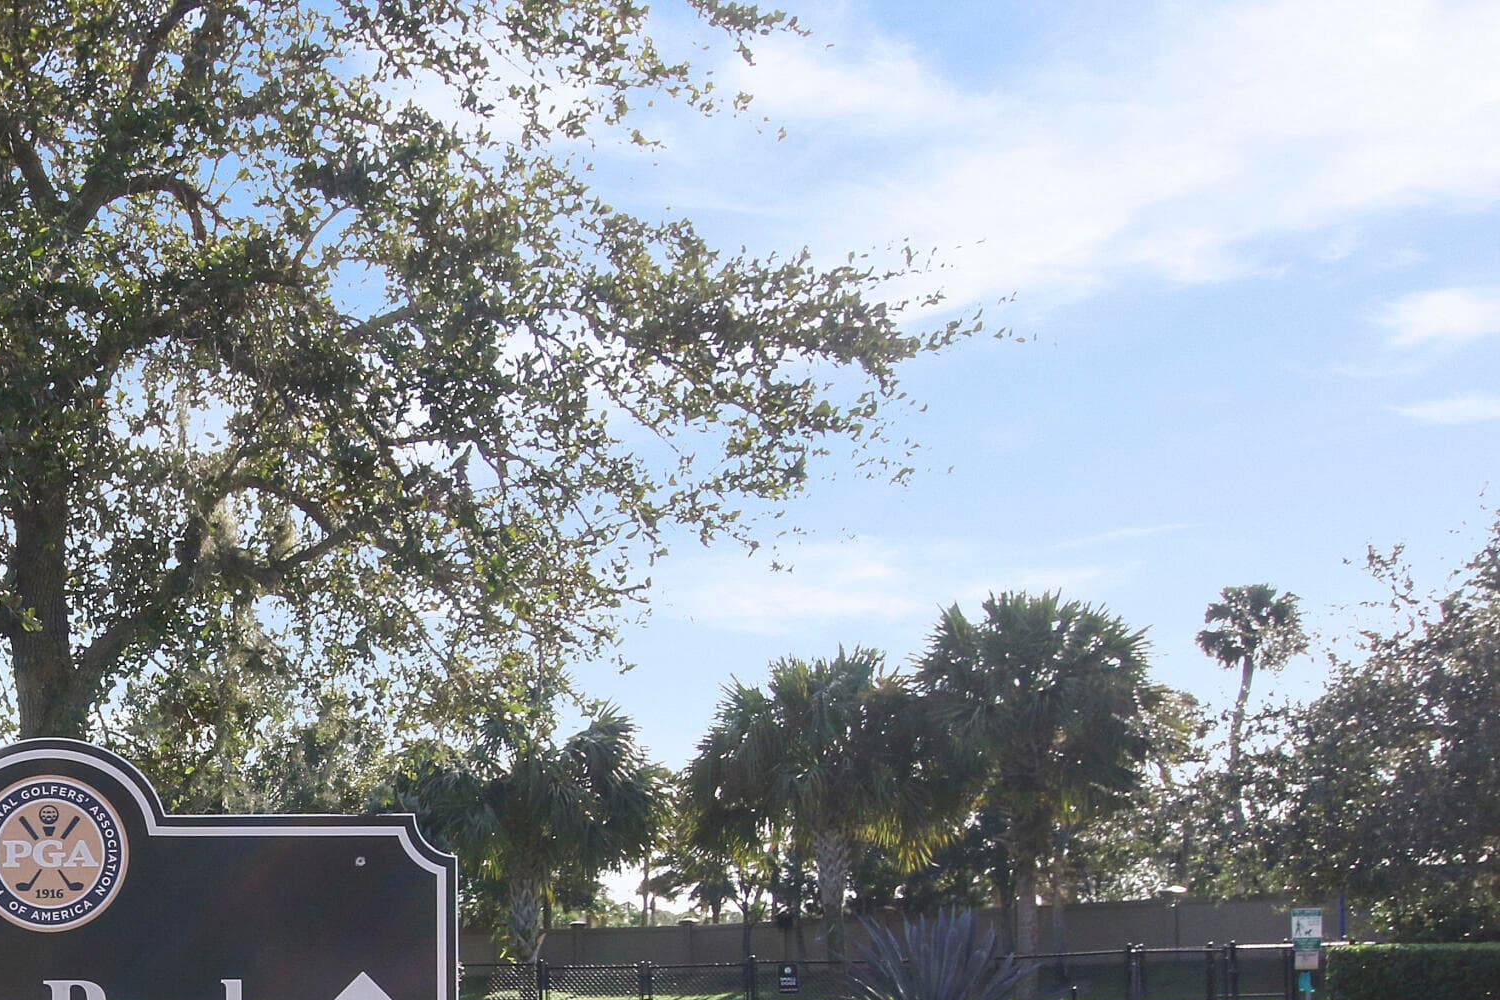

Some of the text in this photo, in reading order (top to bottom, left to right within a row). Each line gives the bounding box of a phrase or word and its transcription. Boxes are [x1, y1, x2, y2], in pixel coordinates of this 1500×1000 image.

[20, 785, 90, 804] GOLFERS'
[90, 805, 118, 896] ASSOCIATION
[2, 839, 100, 868] PGA
[35, 888, 65, 899] 1916
[8, 901, 93, 921] OF AMERICA
